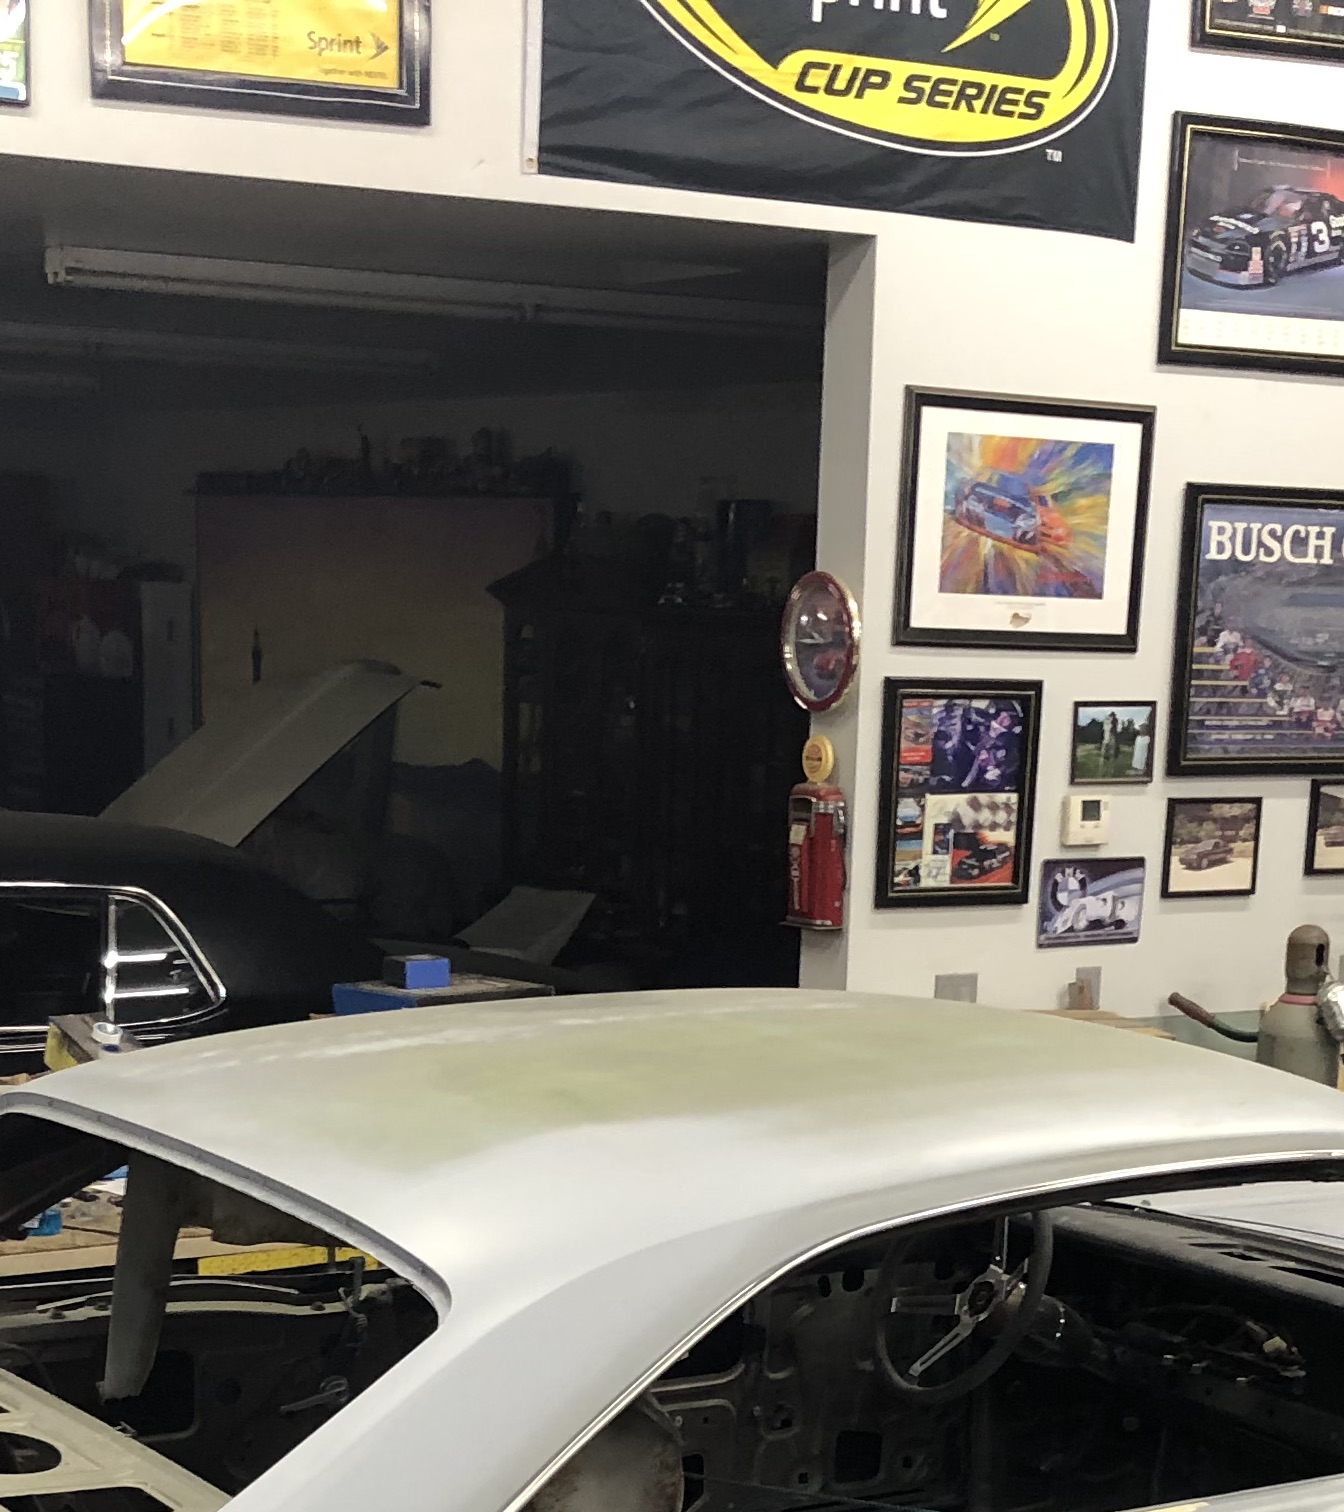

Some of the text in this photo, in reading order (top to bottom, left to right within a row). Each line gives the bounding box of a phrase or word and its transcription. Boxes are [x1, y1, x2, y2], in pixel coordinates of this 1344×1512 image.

[307, 30, 362, 57] Sprint
[794, 60, 1051, 121] CUP SERIES
[1310, 220, 1330, 253] 3
[1205, 520, 1336, 565] BUSCH
